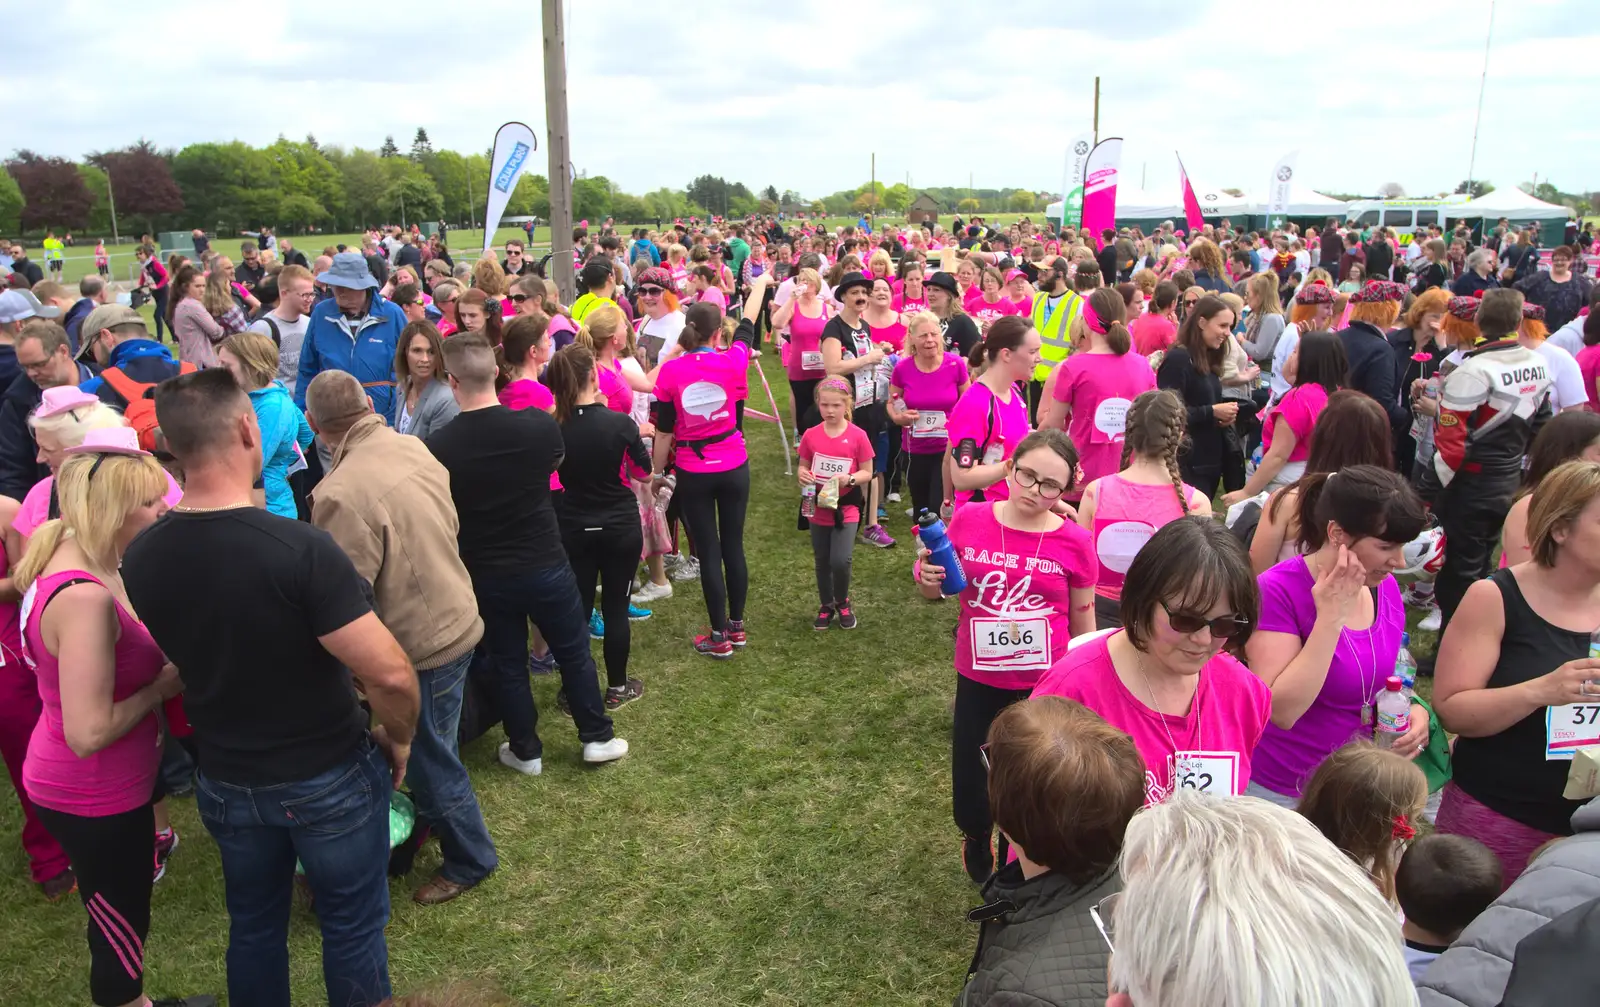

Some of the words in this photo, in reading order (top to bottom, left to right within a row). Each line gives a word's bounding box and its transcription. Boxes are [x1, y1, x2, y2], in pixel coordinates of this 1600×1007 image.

[1501, 366, 1546, 386] DUCATI
[926, 416, 937, 425] 87
[819, 462, 843, 473] 1358
[964, 547, 1020, 569] RACE
[1025, 556, 1064, 576] FOR
[968, 570, 1055, 618] Life
[1572, 705, 1600, 725] 37
